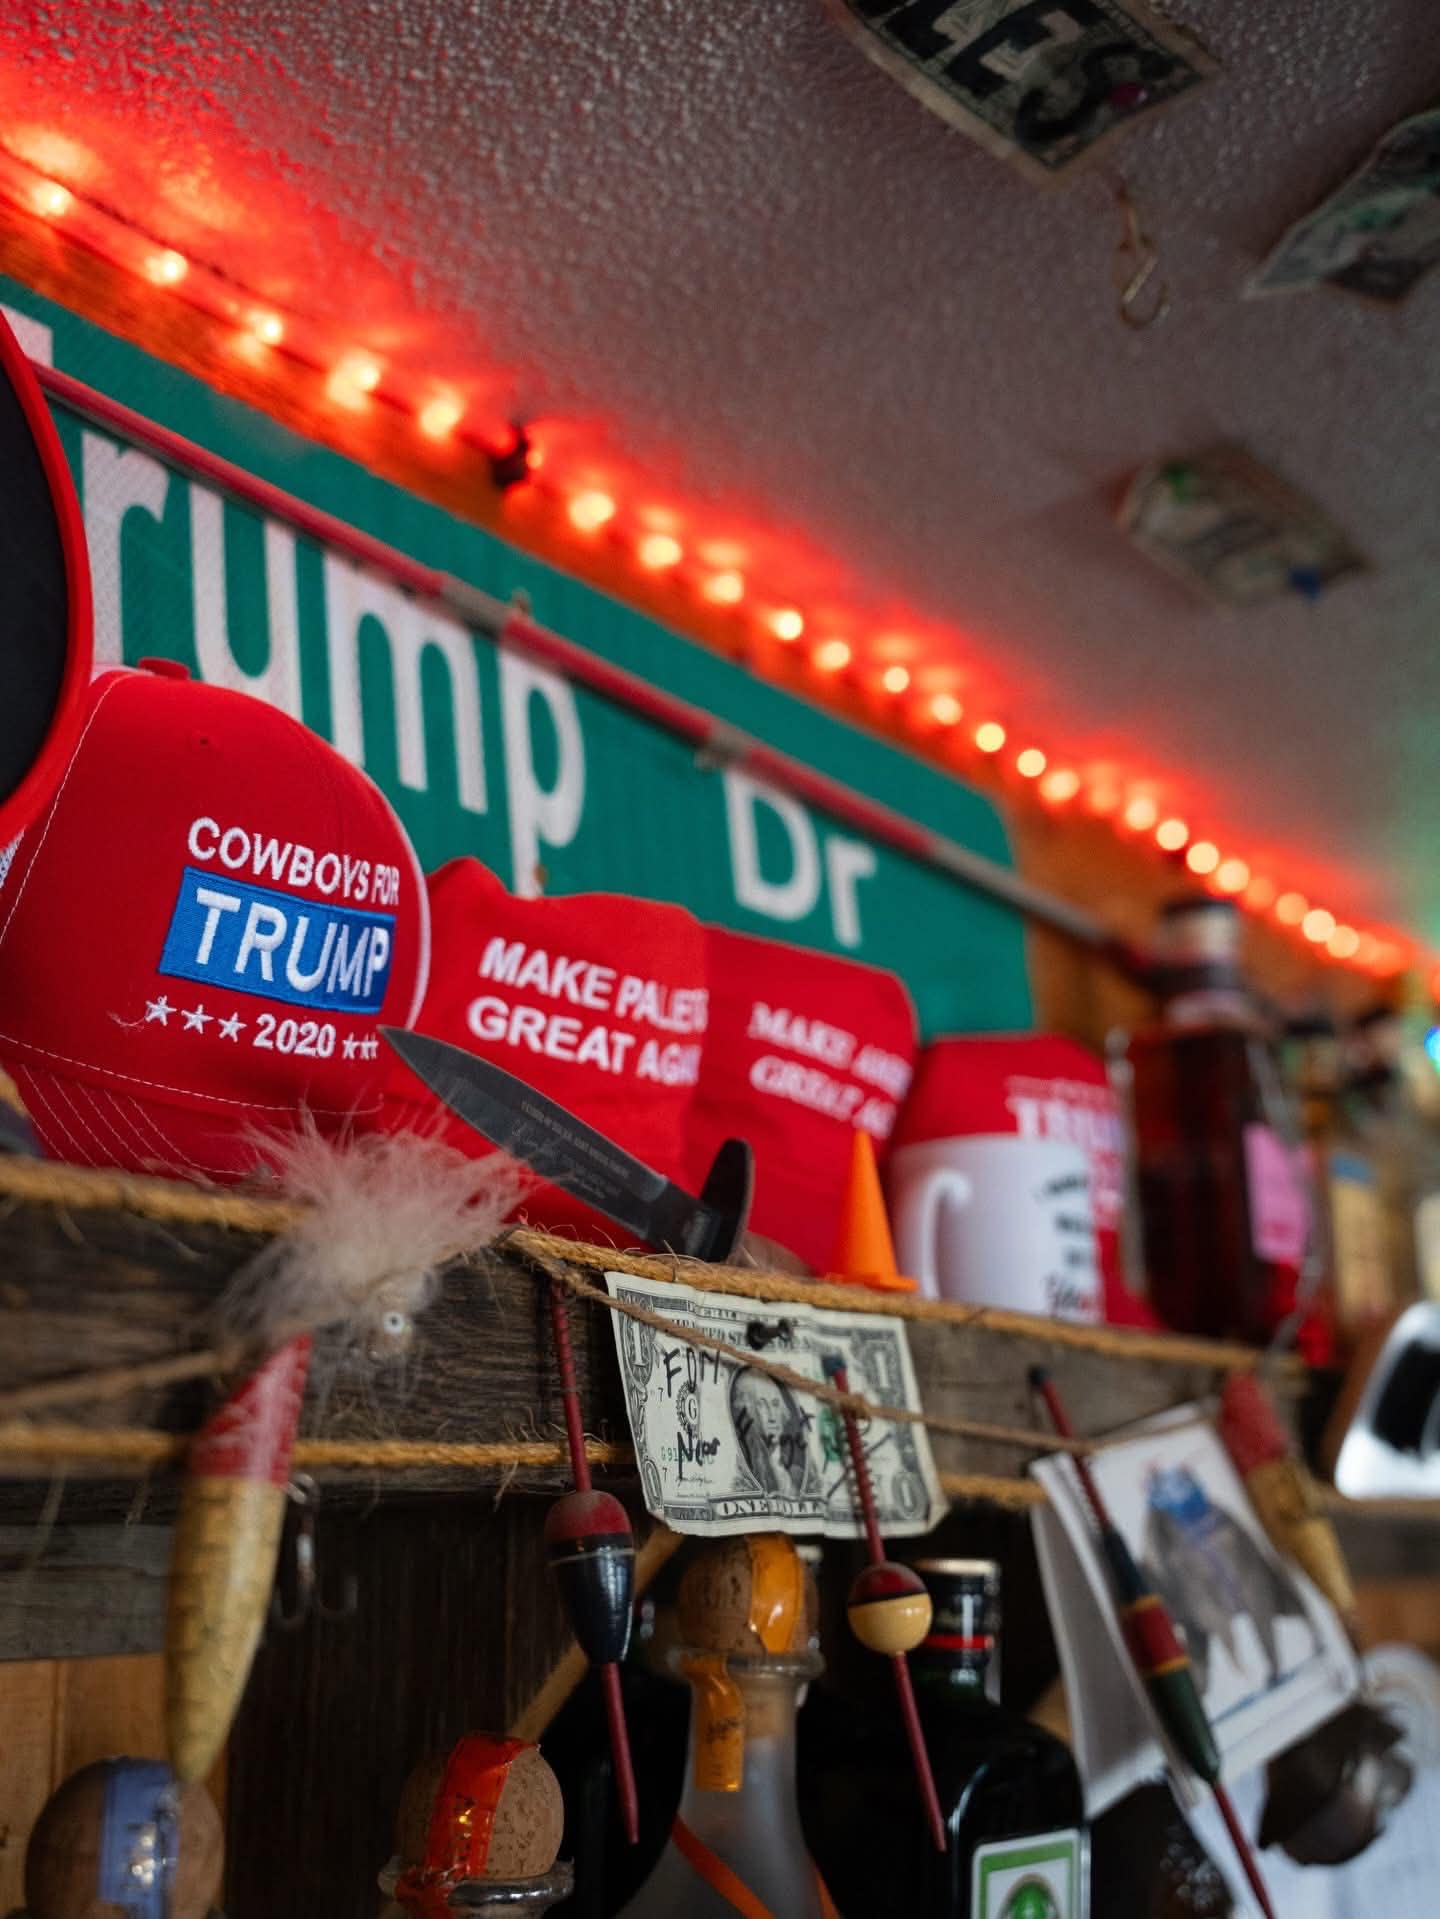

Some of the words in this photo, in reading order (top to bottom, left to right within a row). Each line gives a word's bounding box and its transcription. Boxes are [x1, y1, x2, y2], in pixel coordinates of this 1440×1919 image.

[0, 305, 586, 898] rump
[723, 768, 877, 946] Dr
[187, 817, 369, 900] COWBOYS
[371, 863, 399, 905] FOR
[196, 887, 389, 997] TRUMP
[479, 937, 617, 1010] MAKE
[253, 1013, 336, 1058] 2020
[467, 996, 635, 1075] GREAT
[721, 1500, 768, 1517] ONE
